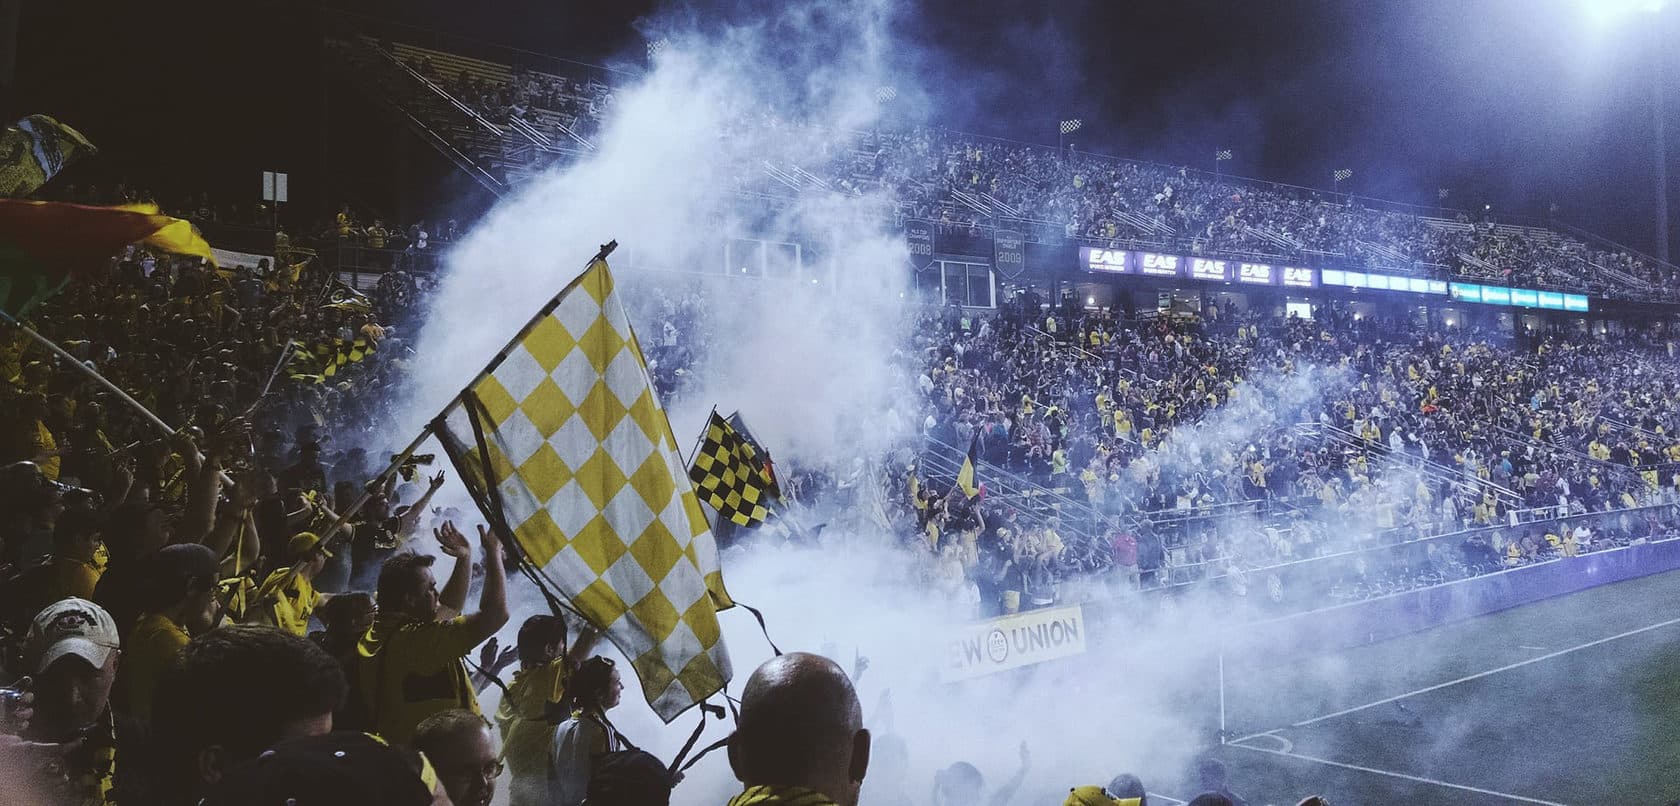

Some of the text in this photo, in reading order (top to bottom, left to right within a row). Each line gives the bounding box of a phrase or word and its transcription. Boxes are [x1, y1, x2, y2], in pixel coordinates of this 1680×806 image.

[998, 251, 1022, 264] 2009
[1089, 250, 1126, 265] EAS
[1144, 254, 1178, 269] EAS
[1193, 259, 1225, 273] EAS
[1240, 263, 1271, 277] EAS
[1284, 267, 1312, 281] EAS
[1012, 617, 1079, 654] UNION
